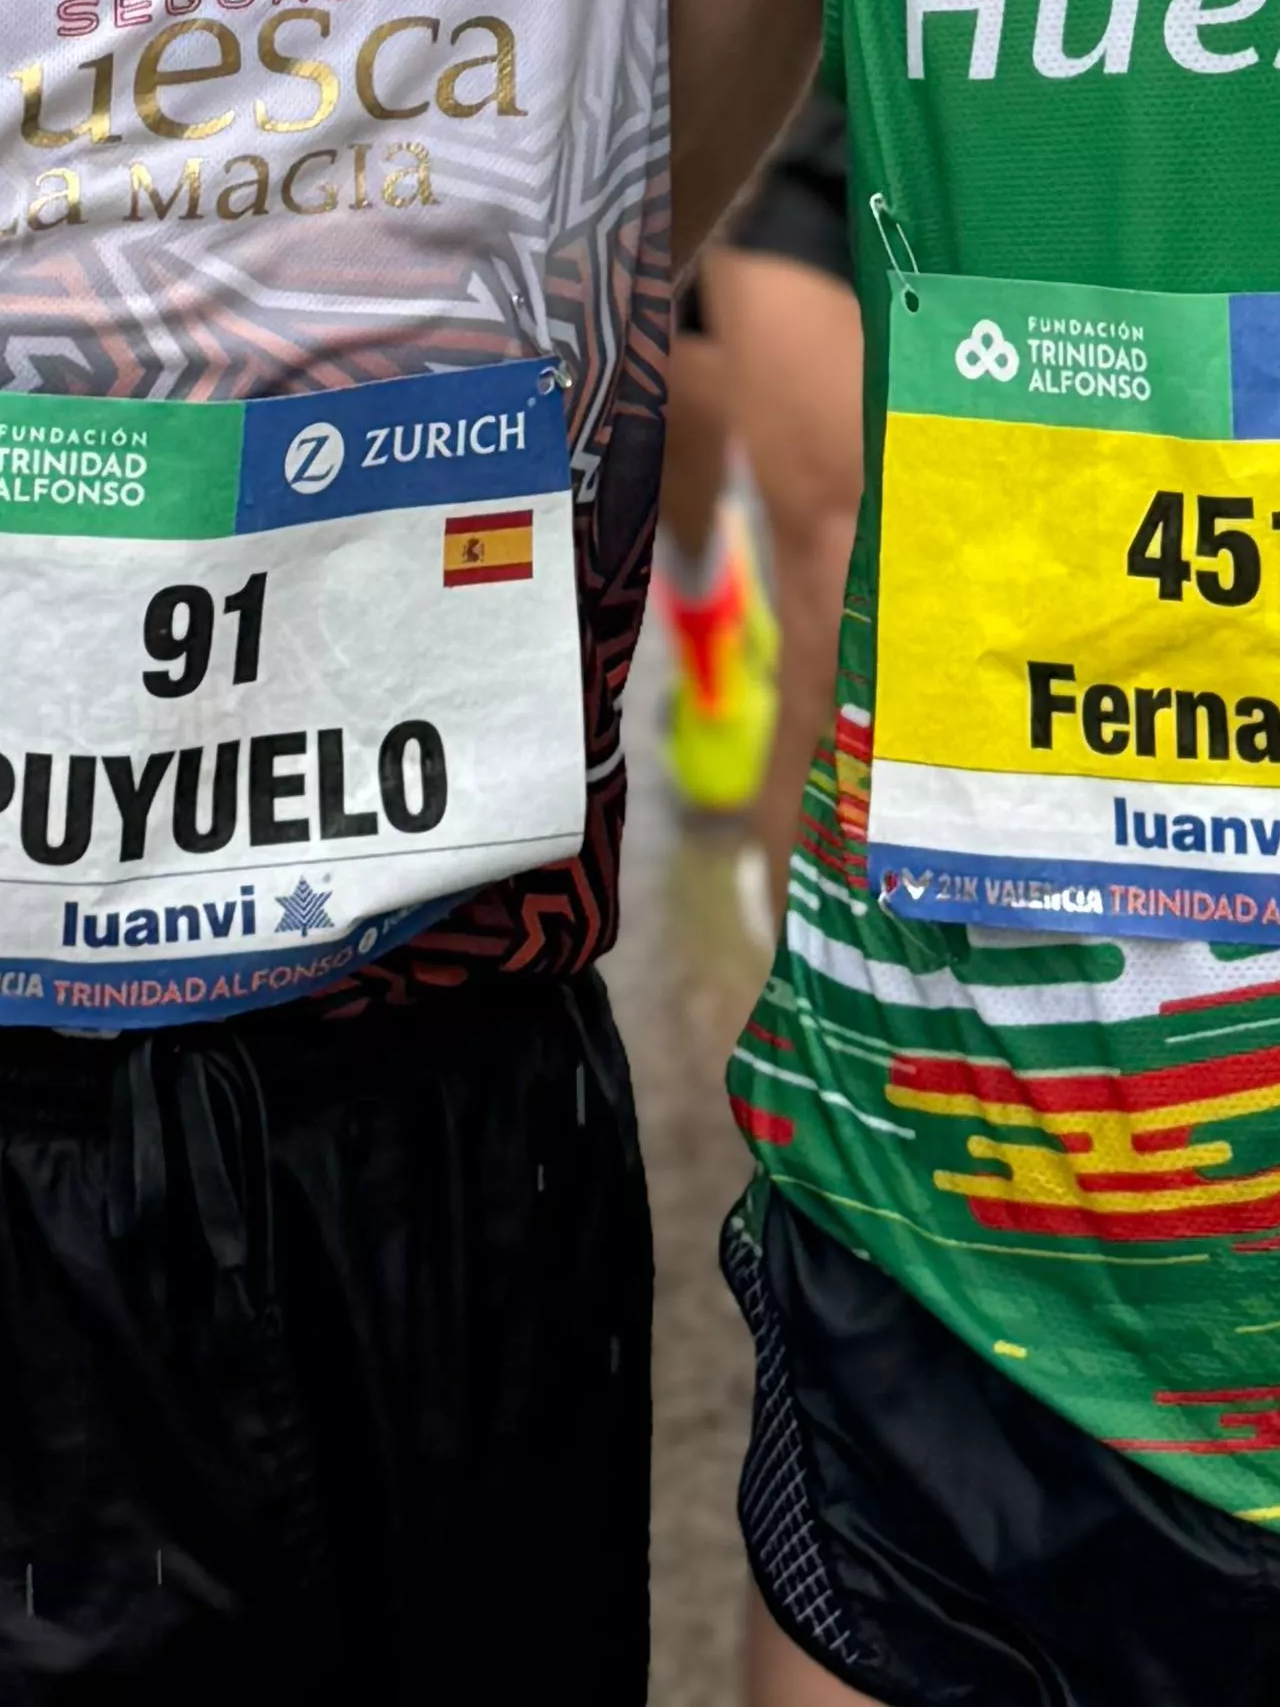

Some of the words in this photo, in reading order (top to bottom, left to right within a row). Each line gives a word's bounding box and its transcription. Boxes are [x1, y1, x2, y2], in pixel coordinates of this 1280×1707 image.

[1028, 315, 1144, 342] FUNDACIÓN
[1026, 339, 1148, 373] TRINIDAD
[1028, 367, 1151, 401] ALFONSO
[361, 411, 526, 467] ZURICH
[141, 572, 269, 699] 91
[1109, 883, 1257, 926] TRINIDAD
[53, 977, 207, 1009] TRINIDAD
[211, 944, 353, 1000] ALFONSO
